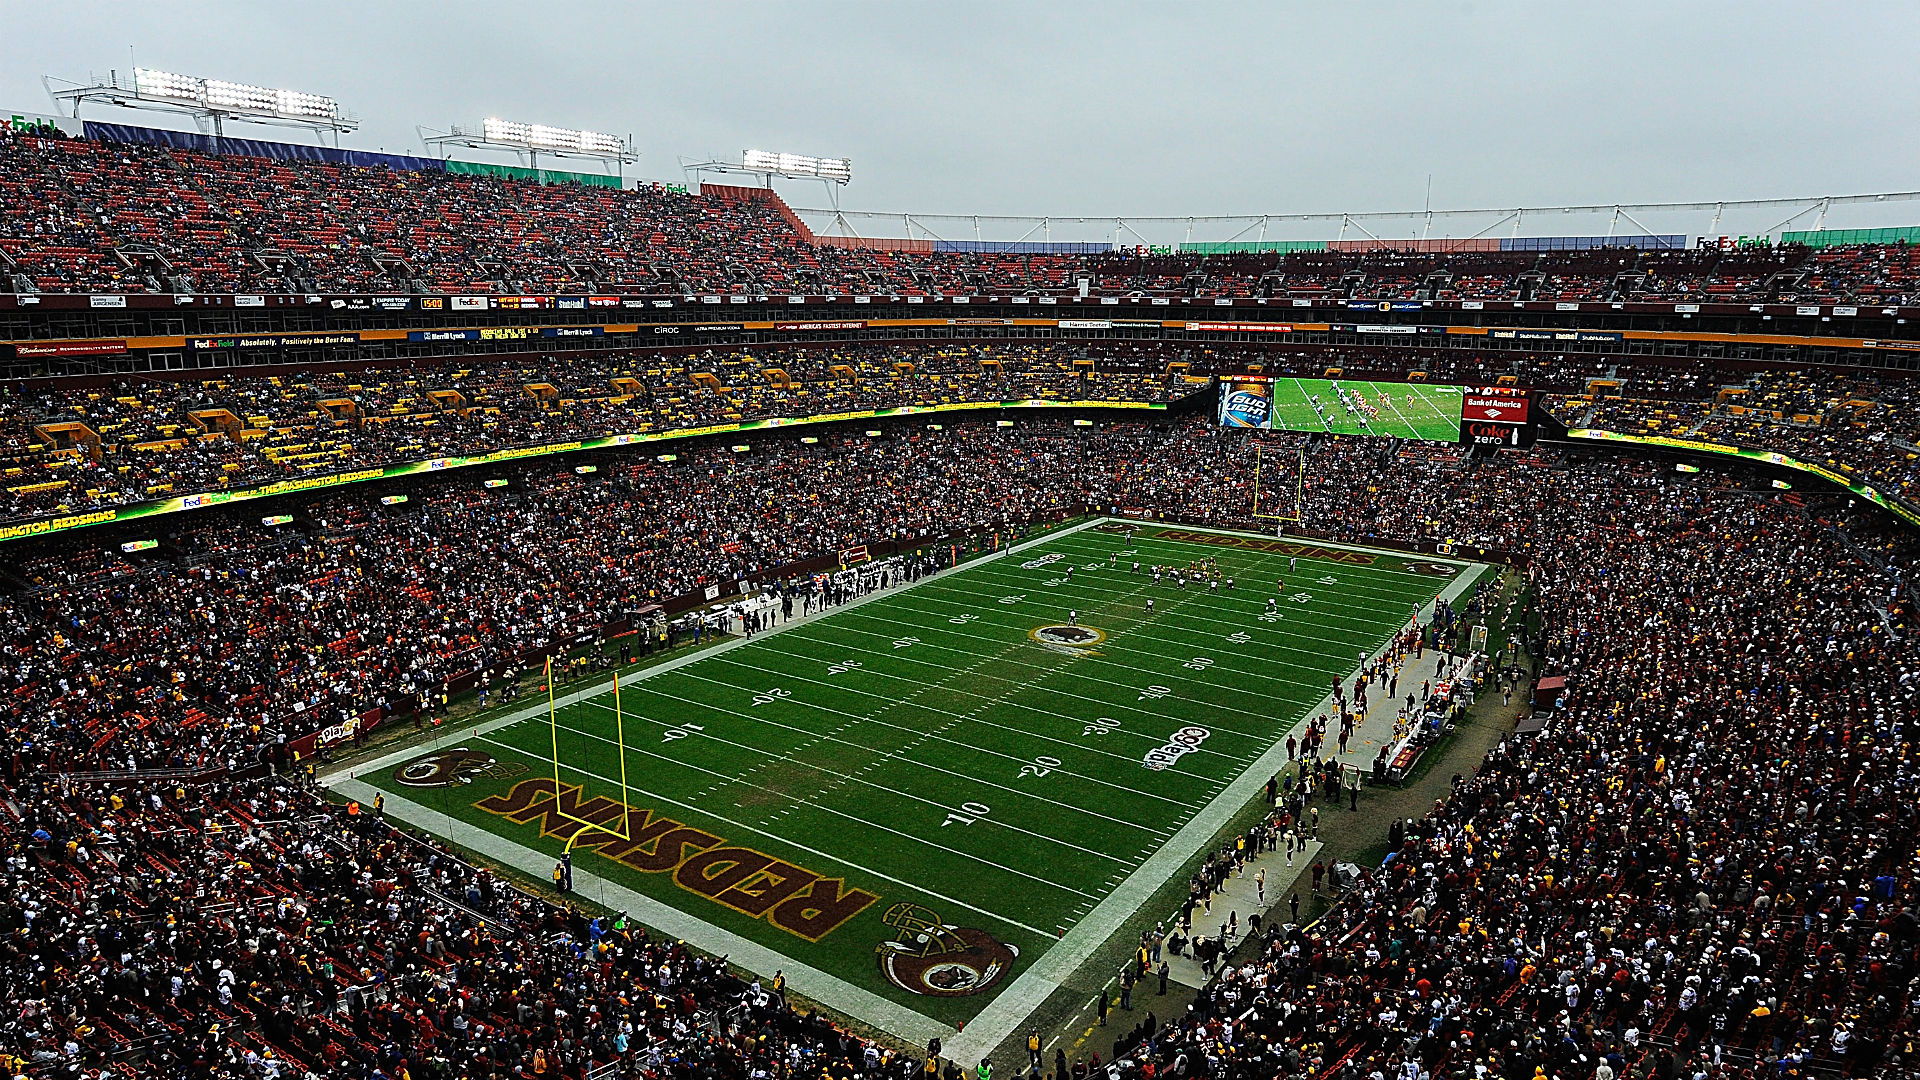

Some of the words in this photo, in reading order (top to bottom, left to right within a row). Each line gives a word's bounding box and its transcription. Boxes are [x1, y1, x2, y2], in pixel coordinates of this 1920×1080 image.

[1696, 234, 1770, 249] FedExField
[1120, 244, 1172, 255] FedExField
[422, 299, 442, 309] 15:00
[458, 298, 480, 306] FedEx
[431, 332, 450, 340] Merrill
[450, 332, 466, 340] Lynch
[563, 328, 580, 336] Merrill
[579, 328, 593, 336] Lynch
[194, 339, 235, 349] FedExField
[239, 339, 278, 347] Absolutely.
[281, 337, 313, 345] Positively
[339, 335, 356, 343] Fans.
[1232, 394, 1267, 409] BUD
[1467, 398, 1486, 407] Bank
[1485, 399, 1493, 407] of
[1492, 399, 1522, 409] America
[1227, 402, 1267, 417] LIGHT
[1469, 422, 1510, 438] Coke
[1474, 435, 1503, 445] zero
[431, 455, 466, 469] FedExField
[500, 445, 547, 458] WASHINGTON
[546, 440, 582, 452] REDSKINS
[183, 490, 231, 508] FedExField
[259, 483, 279, 495] THE
[280, 474, 339, 494] WASHINGTON
[338, 467, 384, 482] REDSKINS
[52, 509, 117, 530] REDSKINS
[1153, 530, 1379, 565] REDSKINS
[892, 635, 921, 649] 40
[827, 659, 864, 675] 30
[1182, 656, 1215, 671] 50
[752, 686, 793, 706] 20
[1142, 684, 1172, 700] 40
[662, 721, 706, 741] 10
[1084, 716, 1122, 735] 30
[1019, 756, 1063, 778] 20
[947, 801, 991, 827] 10
[472, 777, 881, 942] REDSKINS
[1714, 1021, 1725, 1030] 52
